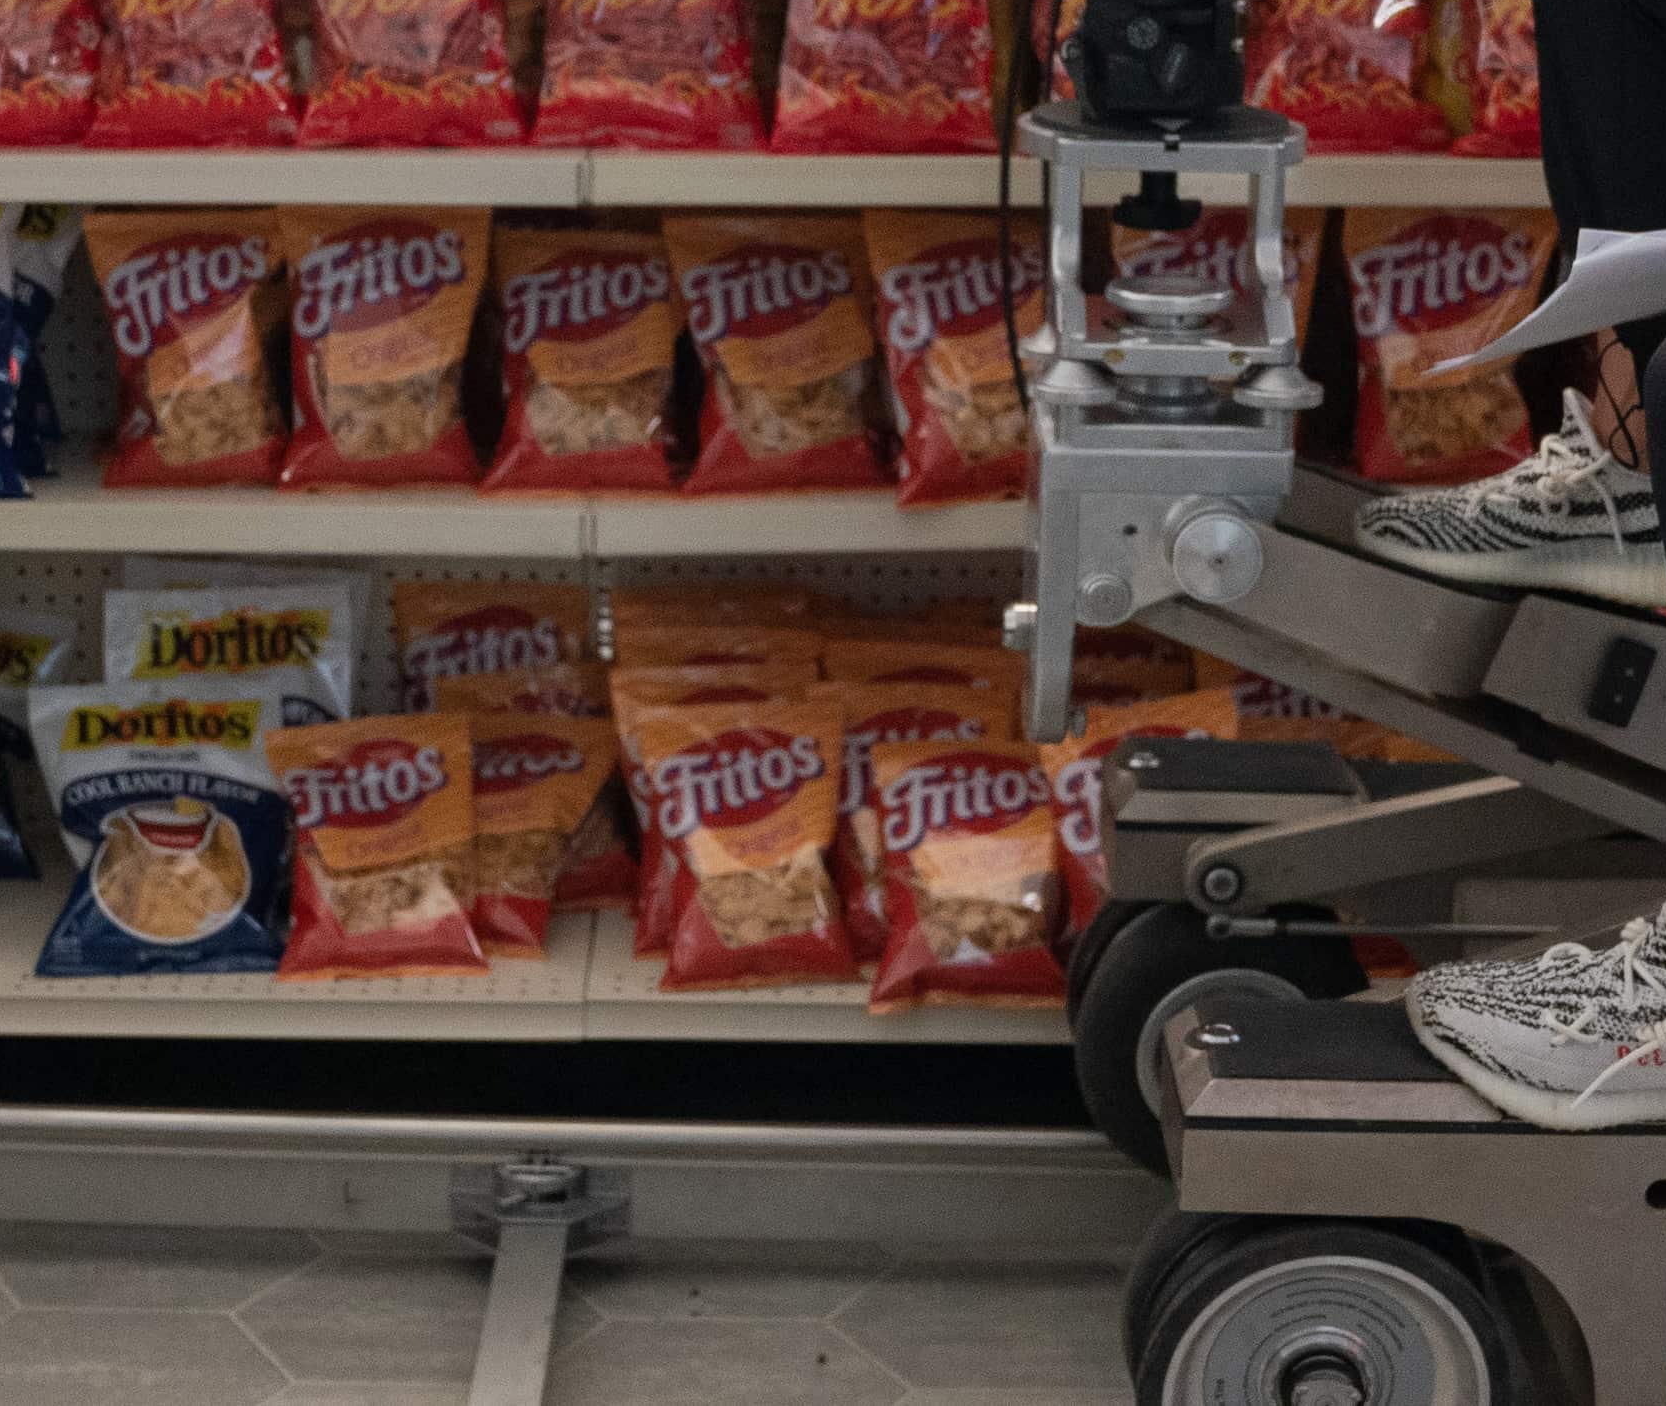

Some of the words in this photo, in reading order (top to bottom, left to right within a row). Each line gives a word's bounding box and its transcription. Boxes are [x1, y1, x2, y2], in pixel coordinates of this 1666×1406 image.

[106, 236, 268, 357] Fritos
[293, 230, 465, 339] Fritos
[503, 258, 671, 354] Fritos
[681, 251, 849, 344] Fritos
[881, 251, 1047, 351] Fritos
[1351, 232, 1533, 337] Fritos
[149, 610, 323, 670] Doritos
[76, 700, 252, 745] Doritos
[287, 745, 447, 827] Fritos
[653, 734, 824, 837] Fritos
[884, 757, 1050, 851] Fritos
